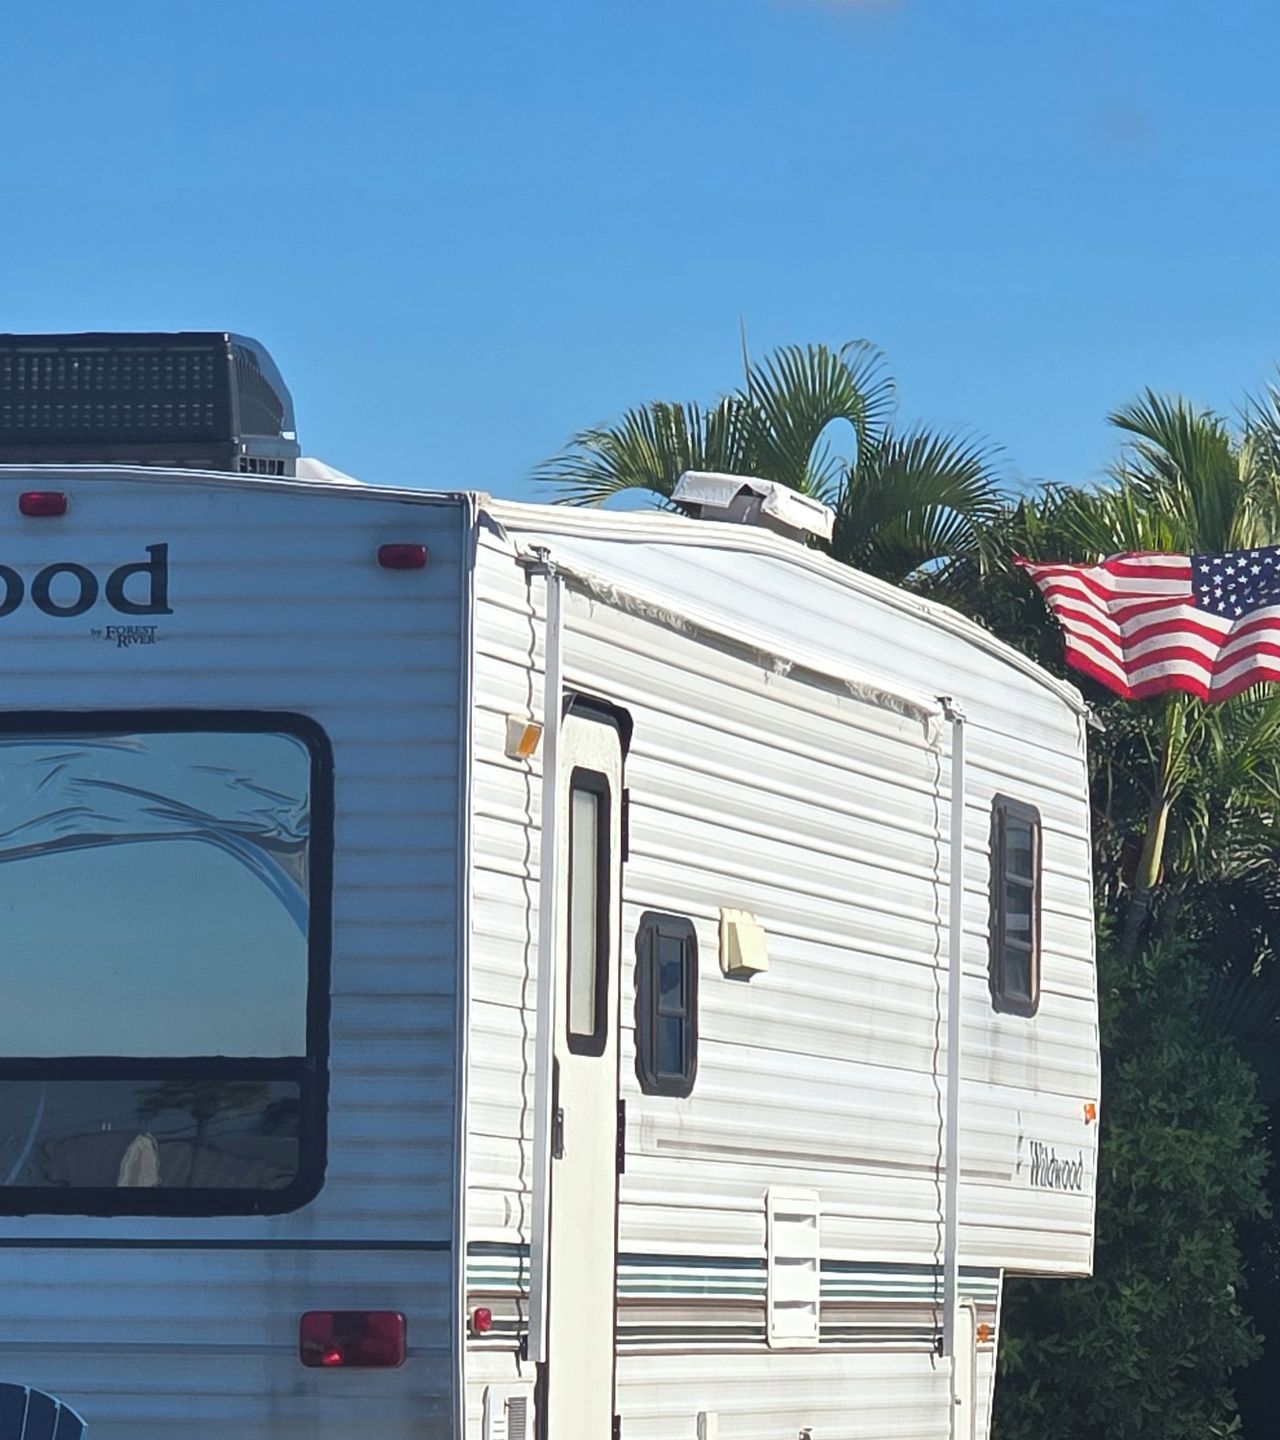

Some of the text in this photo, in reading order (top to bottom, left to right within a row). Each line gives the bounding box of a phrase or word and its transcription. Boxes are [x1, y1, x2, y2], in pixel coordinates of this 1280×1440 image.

[106, 625, 158, 640] FOREST
[117, 634, 157, 648] RIVER
[1030, 1140, 1084, 1191] Wildwood
